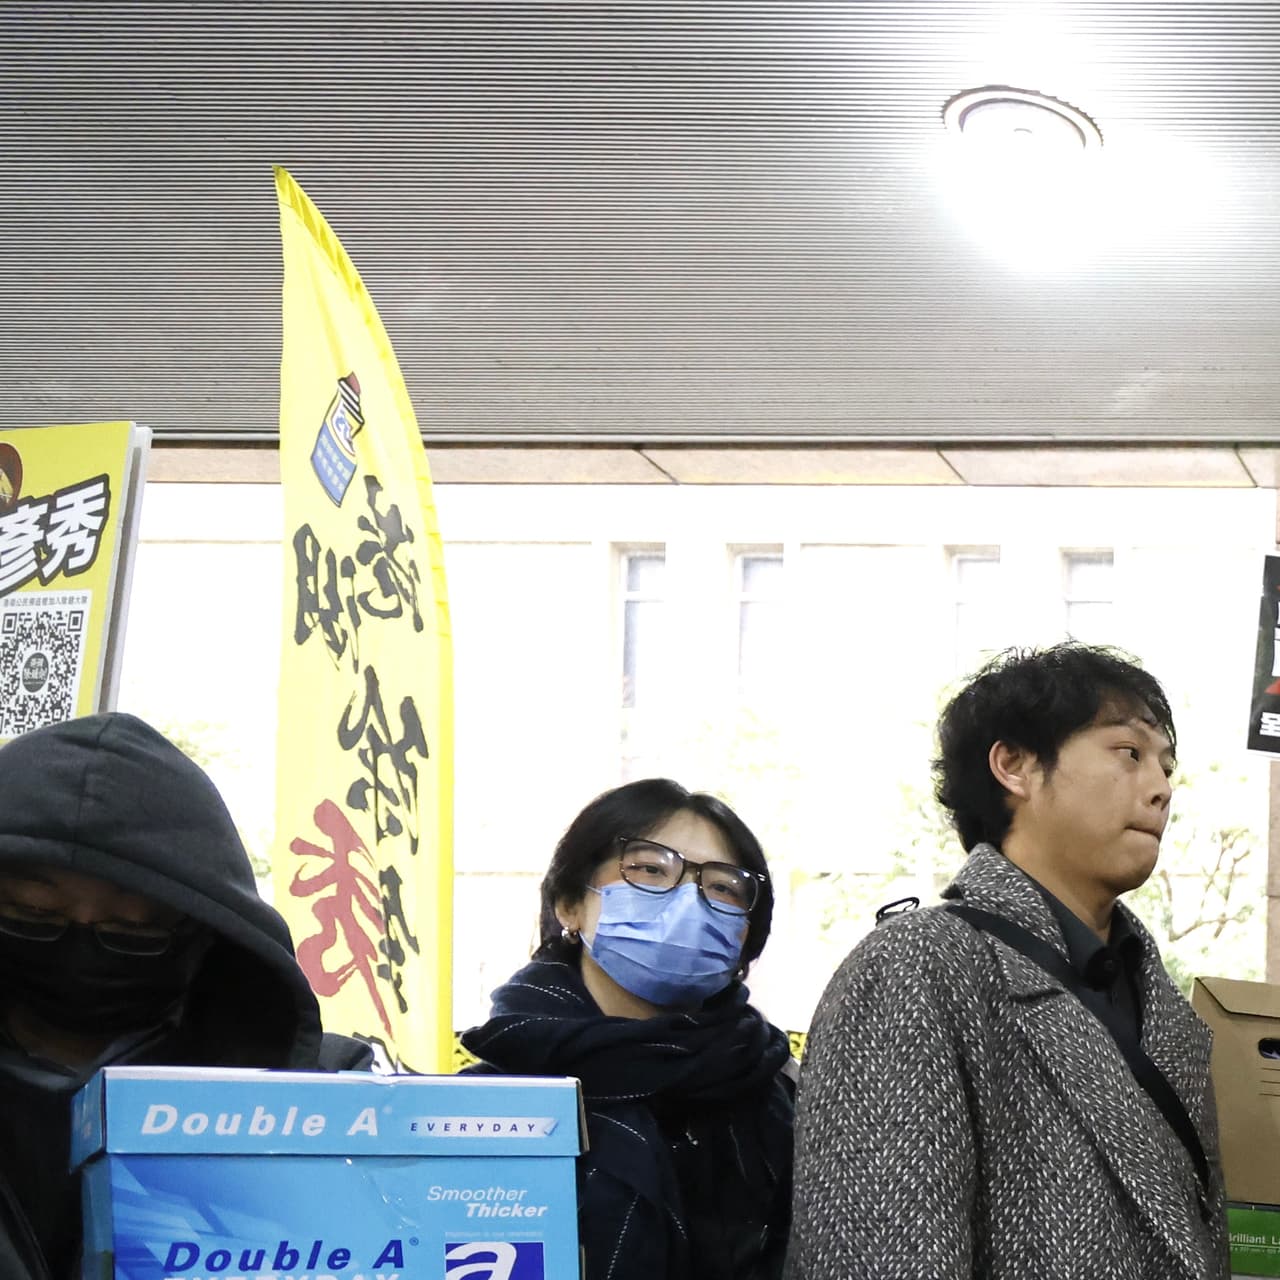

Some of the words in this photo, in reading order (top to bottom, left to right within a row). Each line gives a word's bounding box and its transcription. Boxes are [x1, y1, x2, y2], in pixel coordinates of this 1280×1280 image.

[142, 1104, 326, 1137] Double
[347, 1107, 379, 1136] A
[410, 1122, 537, 1133] EVERYDAY
[428, 1186, 528, 1201] Smoother
[466, 1203, 548, 1217] Thicker
[163, 1240, 351, 1272] Double
[372, 1239, 405, 1269] A
